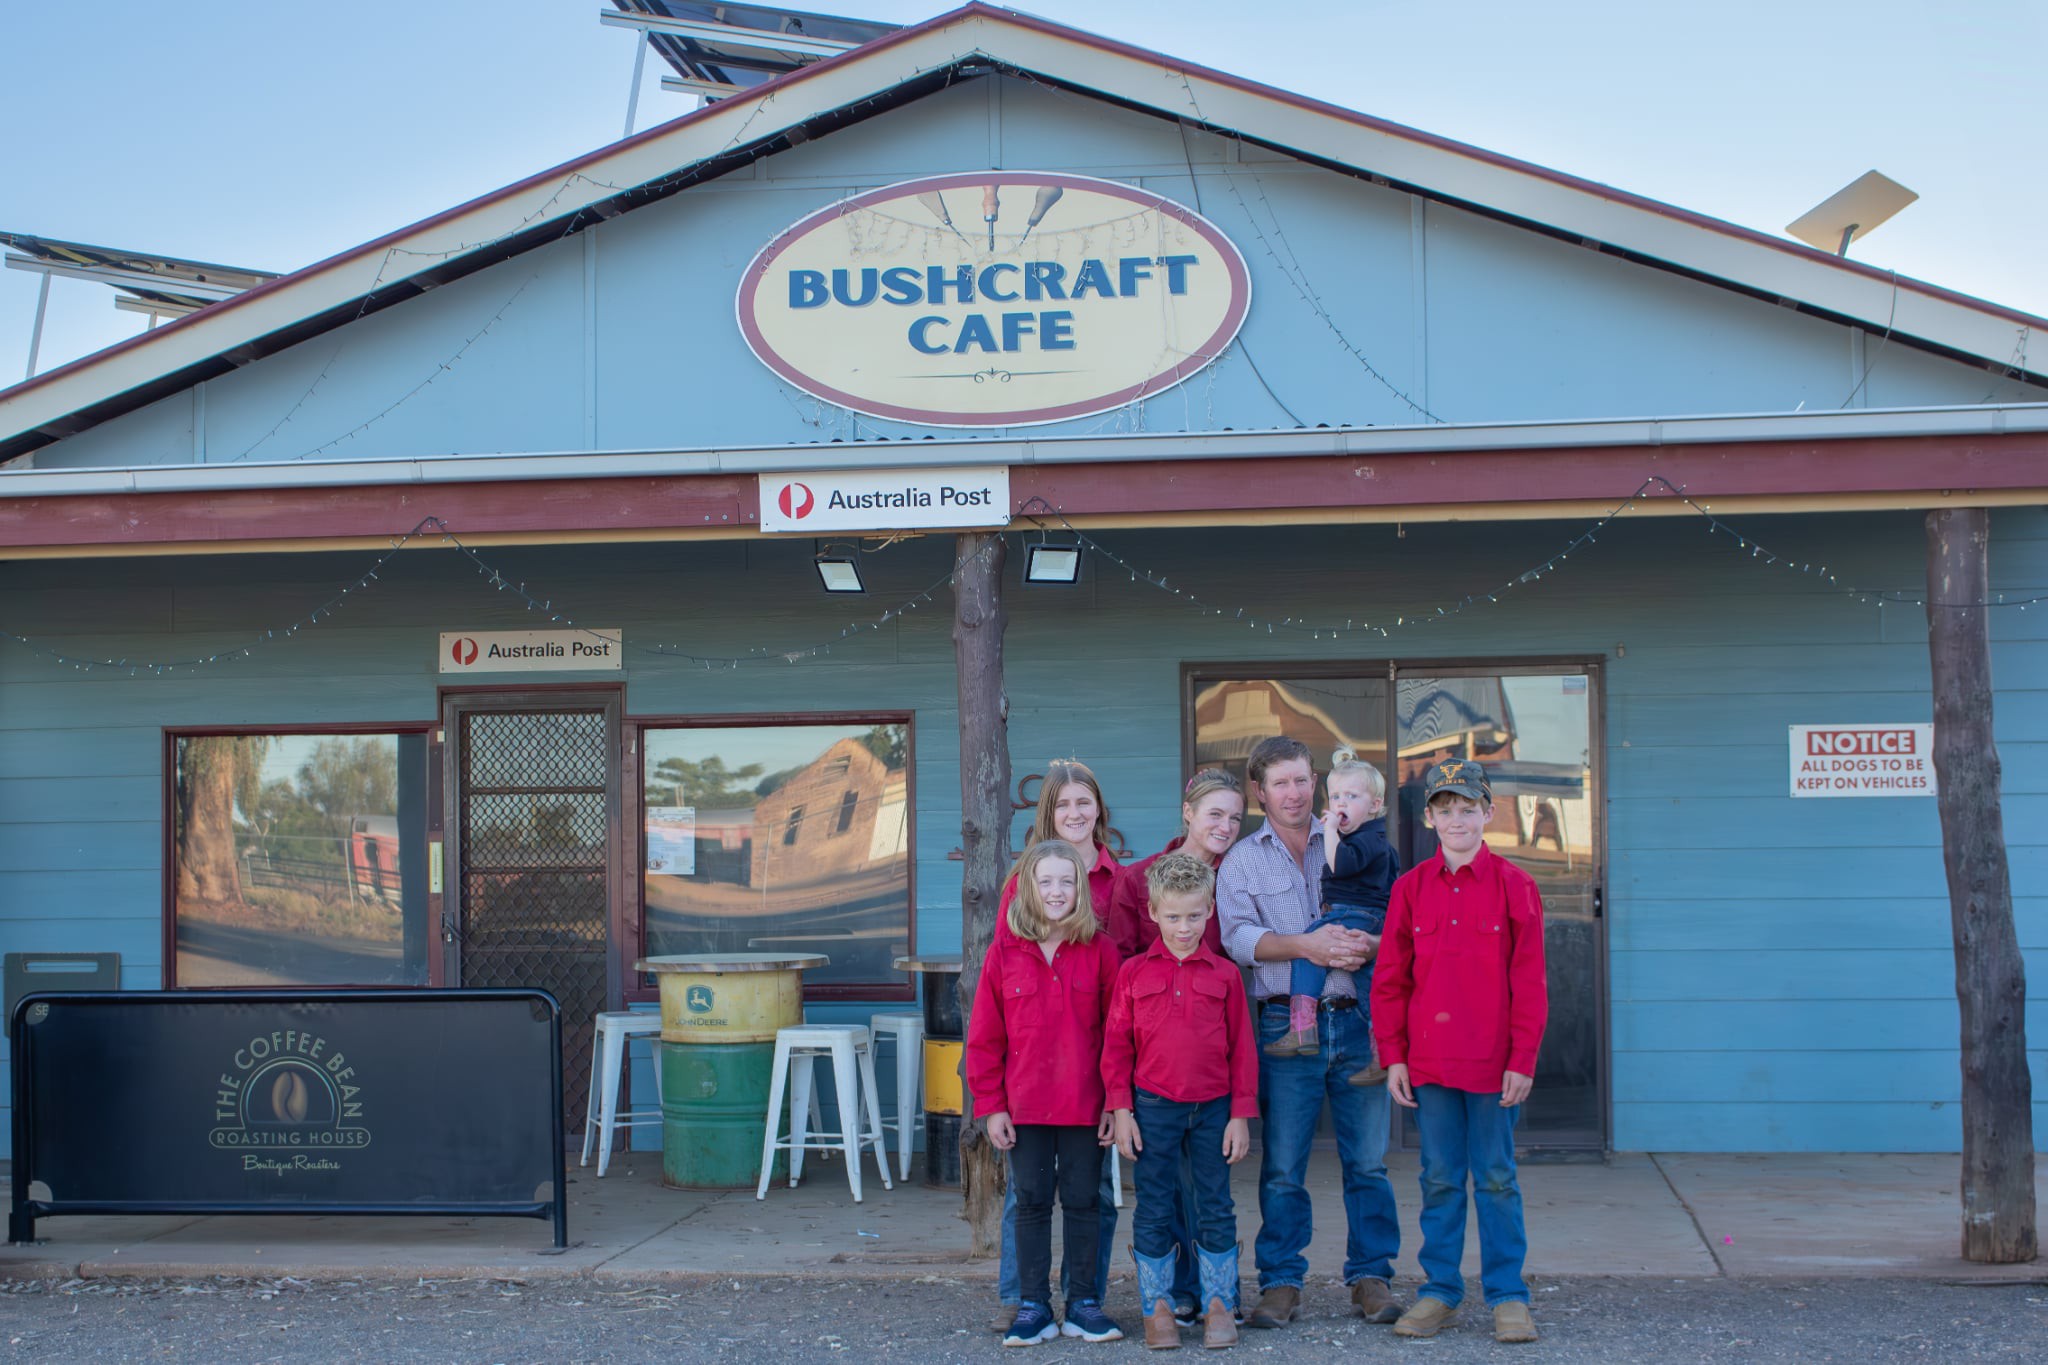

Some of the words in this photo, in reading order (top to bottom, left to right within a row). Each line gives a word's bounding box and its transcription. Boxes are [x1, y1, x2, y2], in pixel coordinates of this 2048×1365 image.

[788, 254, 1199, 309] BUSHCRAFT
[908, 310, 1076, 355] CAFE
[828, 487, 932, 510] Australia
[940, 486, 992, 506] Post
[488, 642, 565, 658] Australia
[572, 641, 610, 657] Post
[1811, 731, 1912, 754] NOTICE
[1801, 760, 1828, 772] ALL
[1832, 759, 1878, 772] DOGS
[1881, 759, 1902, 771] TO
[1906, 759, 1924, 771] BE
[1797, 777, 1831, 790] KEPT
[1834, 777, 1858, 789] ON
[1861, 776, 1927, 789] VEHICLES
[697, 1018, 729, 1026] DEERE
[216, 1073, 241, 1121] THE
[234, 1030, 326, 1070] COFFEE
[326, 1052, 363, 1118] BEAN
[216, 1131, 301, 1145] ROASTING
[310, 1131, 364, 1145] HOUSE
[241, 1154, 293, 1177] Boutique
[292, 1154, 341, 1170] Roasters
